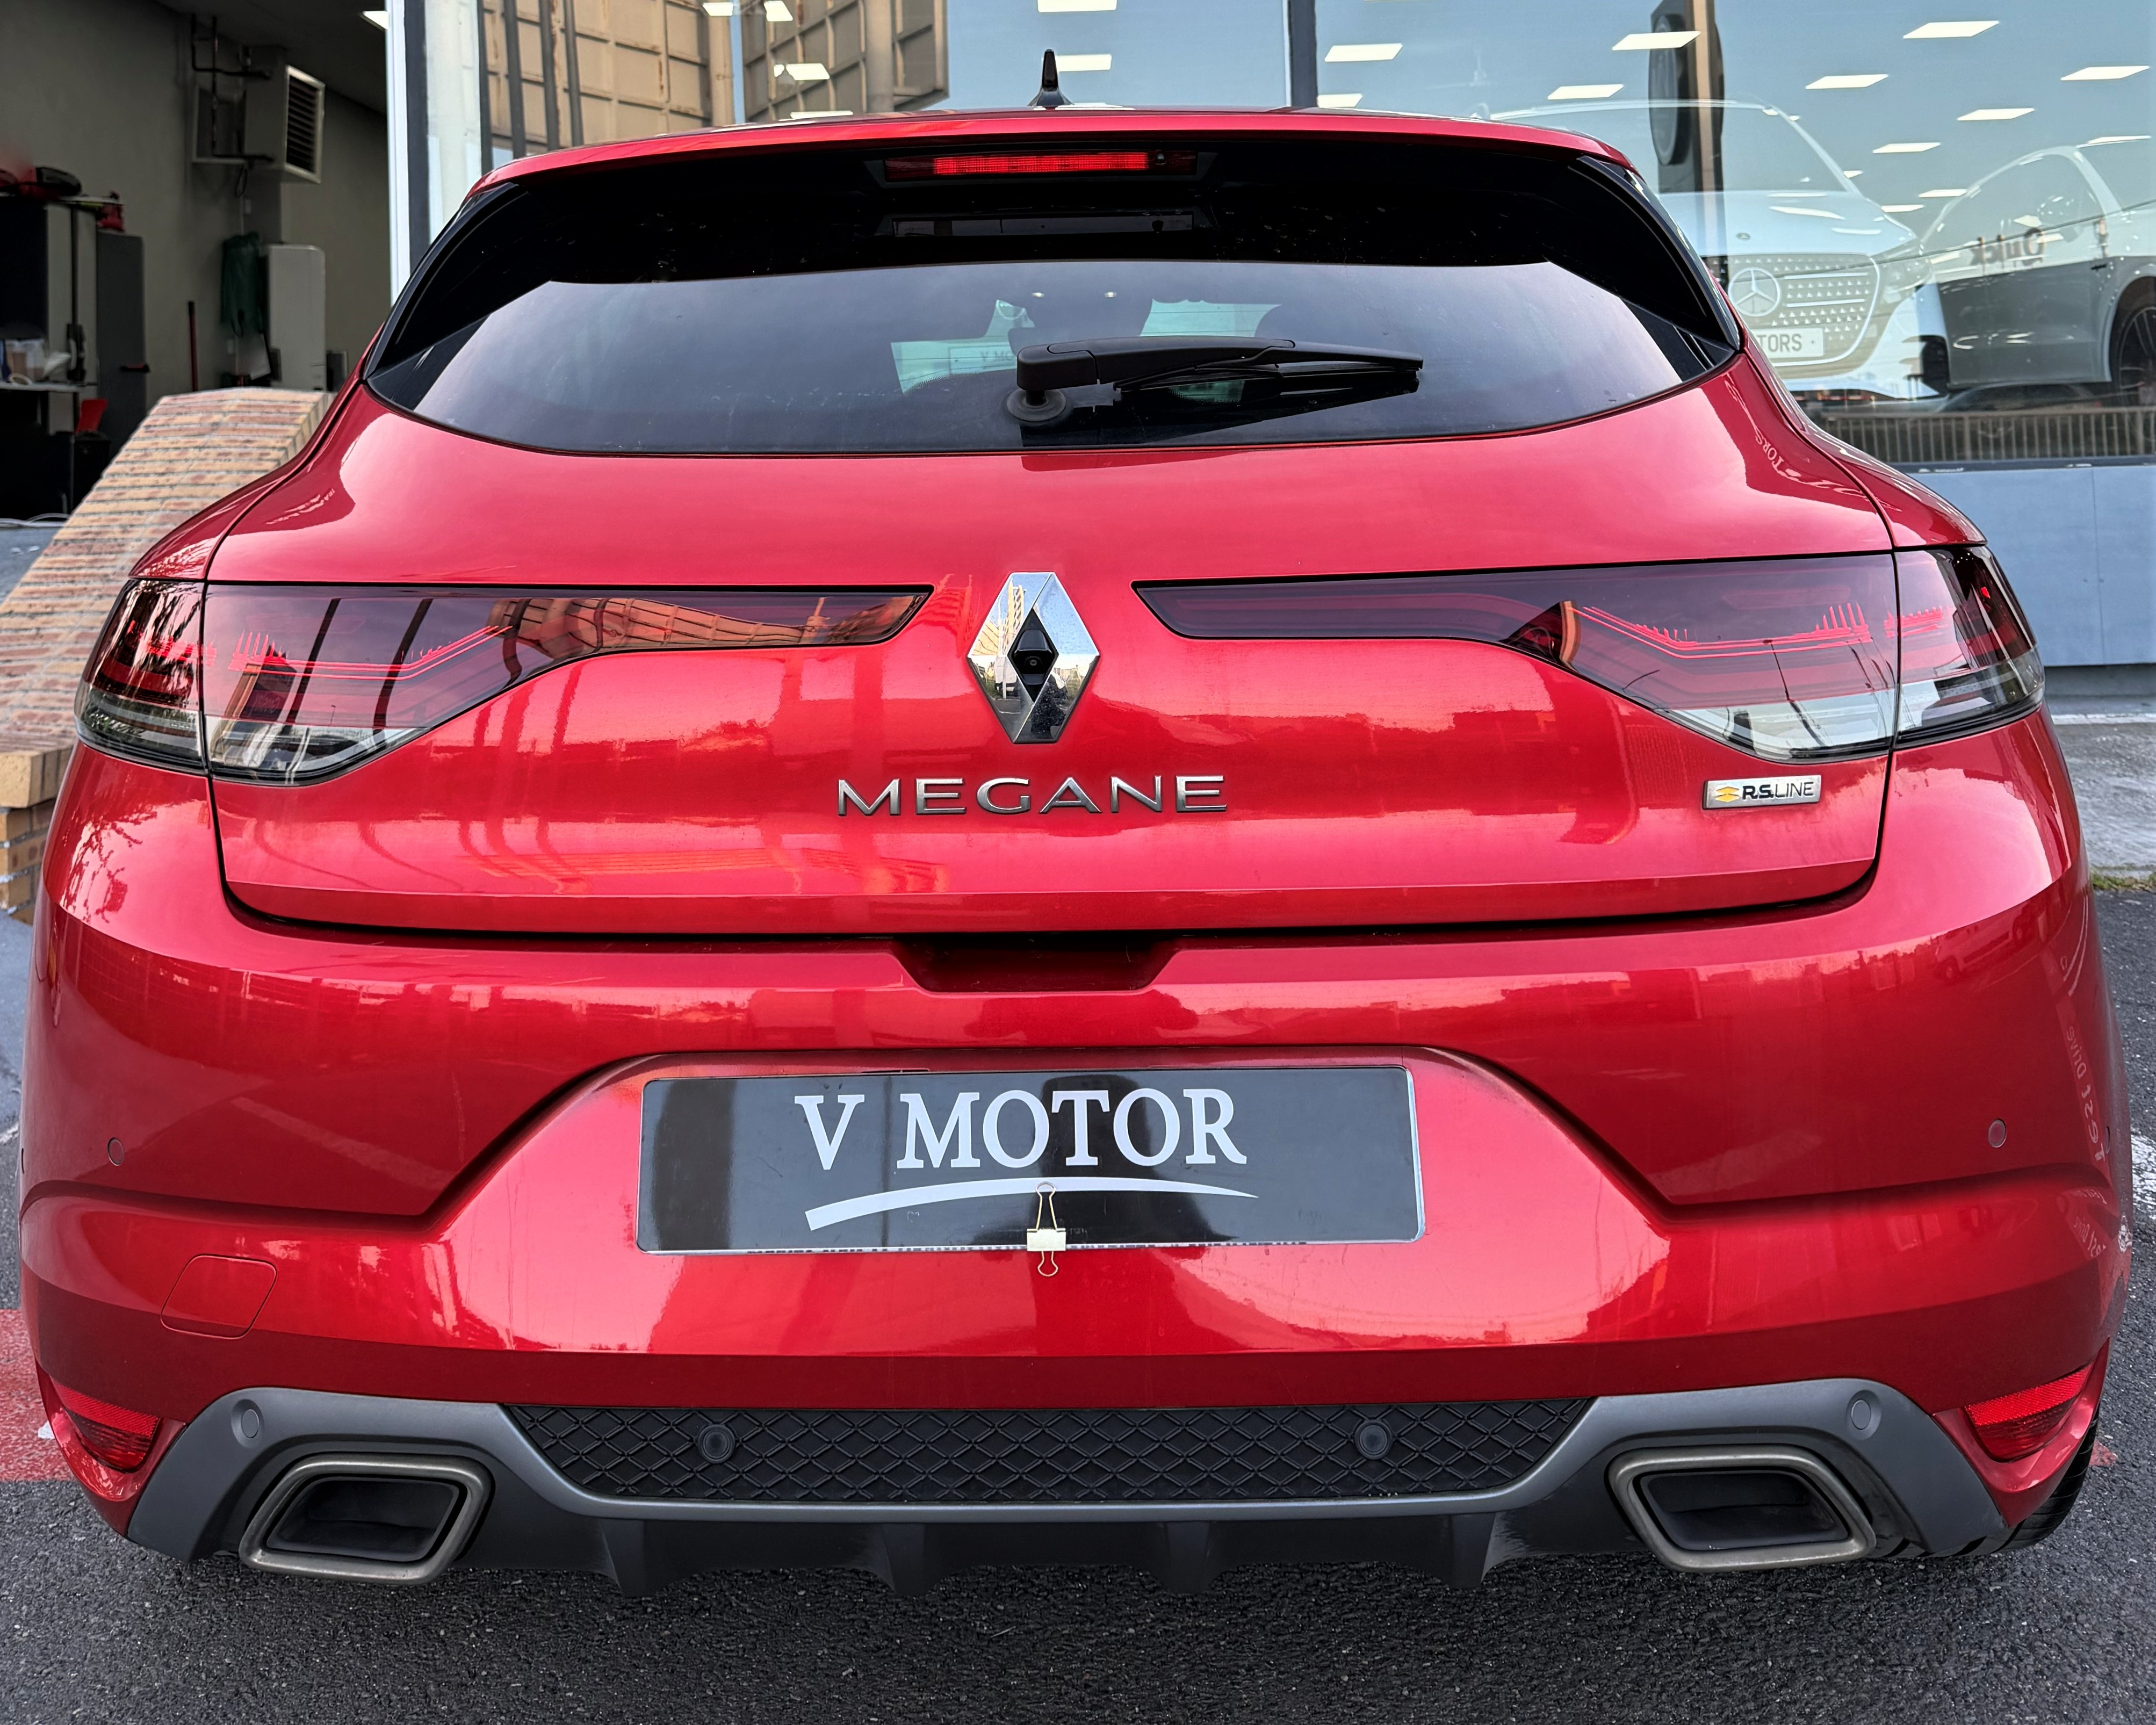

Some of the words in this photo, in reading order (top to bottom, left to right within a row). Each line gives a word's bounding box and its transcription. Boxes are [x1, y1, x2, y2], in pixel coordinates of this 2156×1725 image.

[837, 775, 1227, 815] MEGANE
[794, 1094, 865, 1170] V
[896, 1088, 1248, 1169] MOTOR
